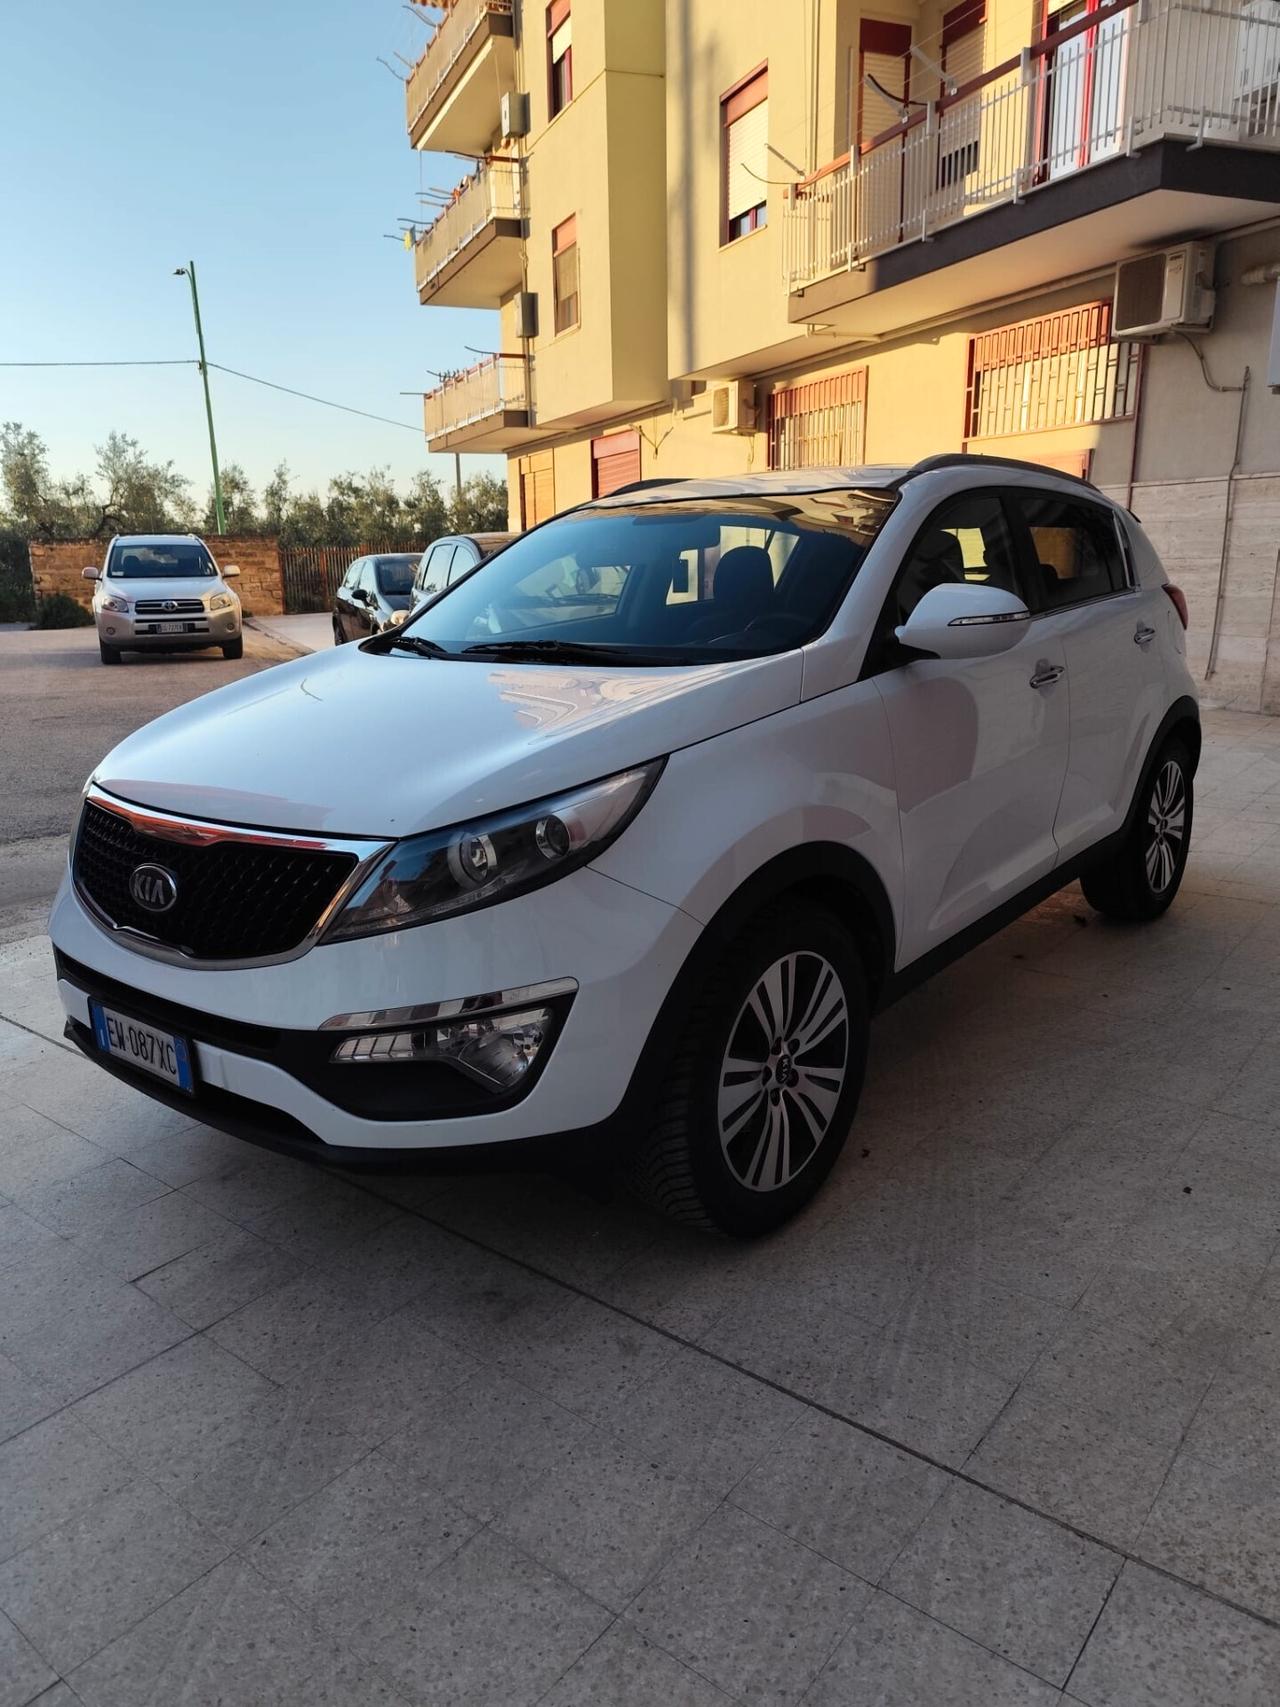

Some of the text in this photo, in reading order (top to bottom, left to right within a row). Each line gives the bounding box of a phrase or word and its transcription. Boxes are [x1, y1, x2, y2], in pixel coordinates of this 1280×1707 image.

[134, 873, 165, 905] KIA
[106, 1016, 176, 1075] EW 087XC
